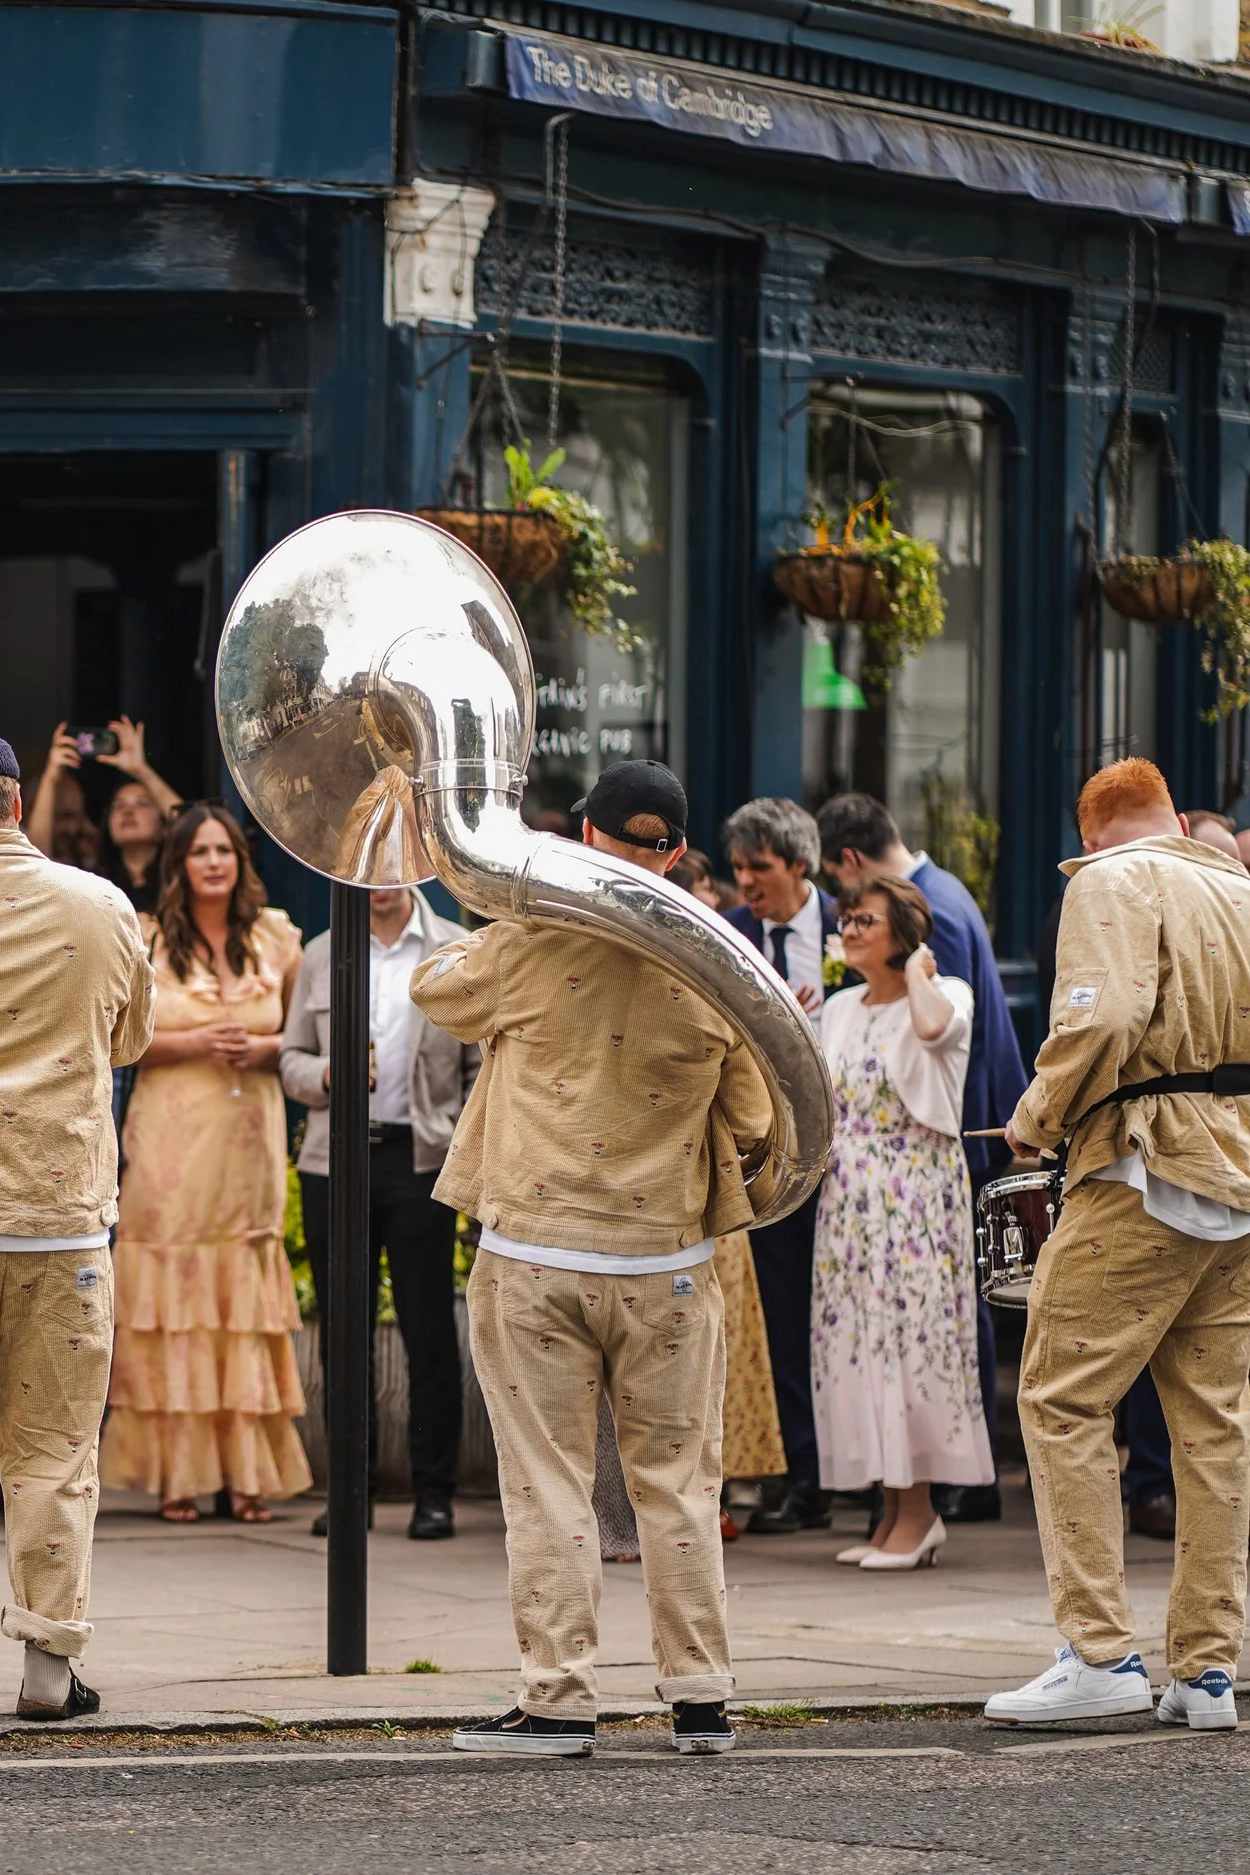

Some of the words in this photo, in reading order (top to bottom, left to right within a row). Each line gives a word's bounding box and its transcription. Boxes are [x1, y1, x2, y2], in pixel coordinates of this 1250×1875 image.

[525, 46, 572, 88] The
[573, 54, 633, 99] Duke
[635, 71, 659, 104] of
[661, 73, 774, 137] Cambridge
